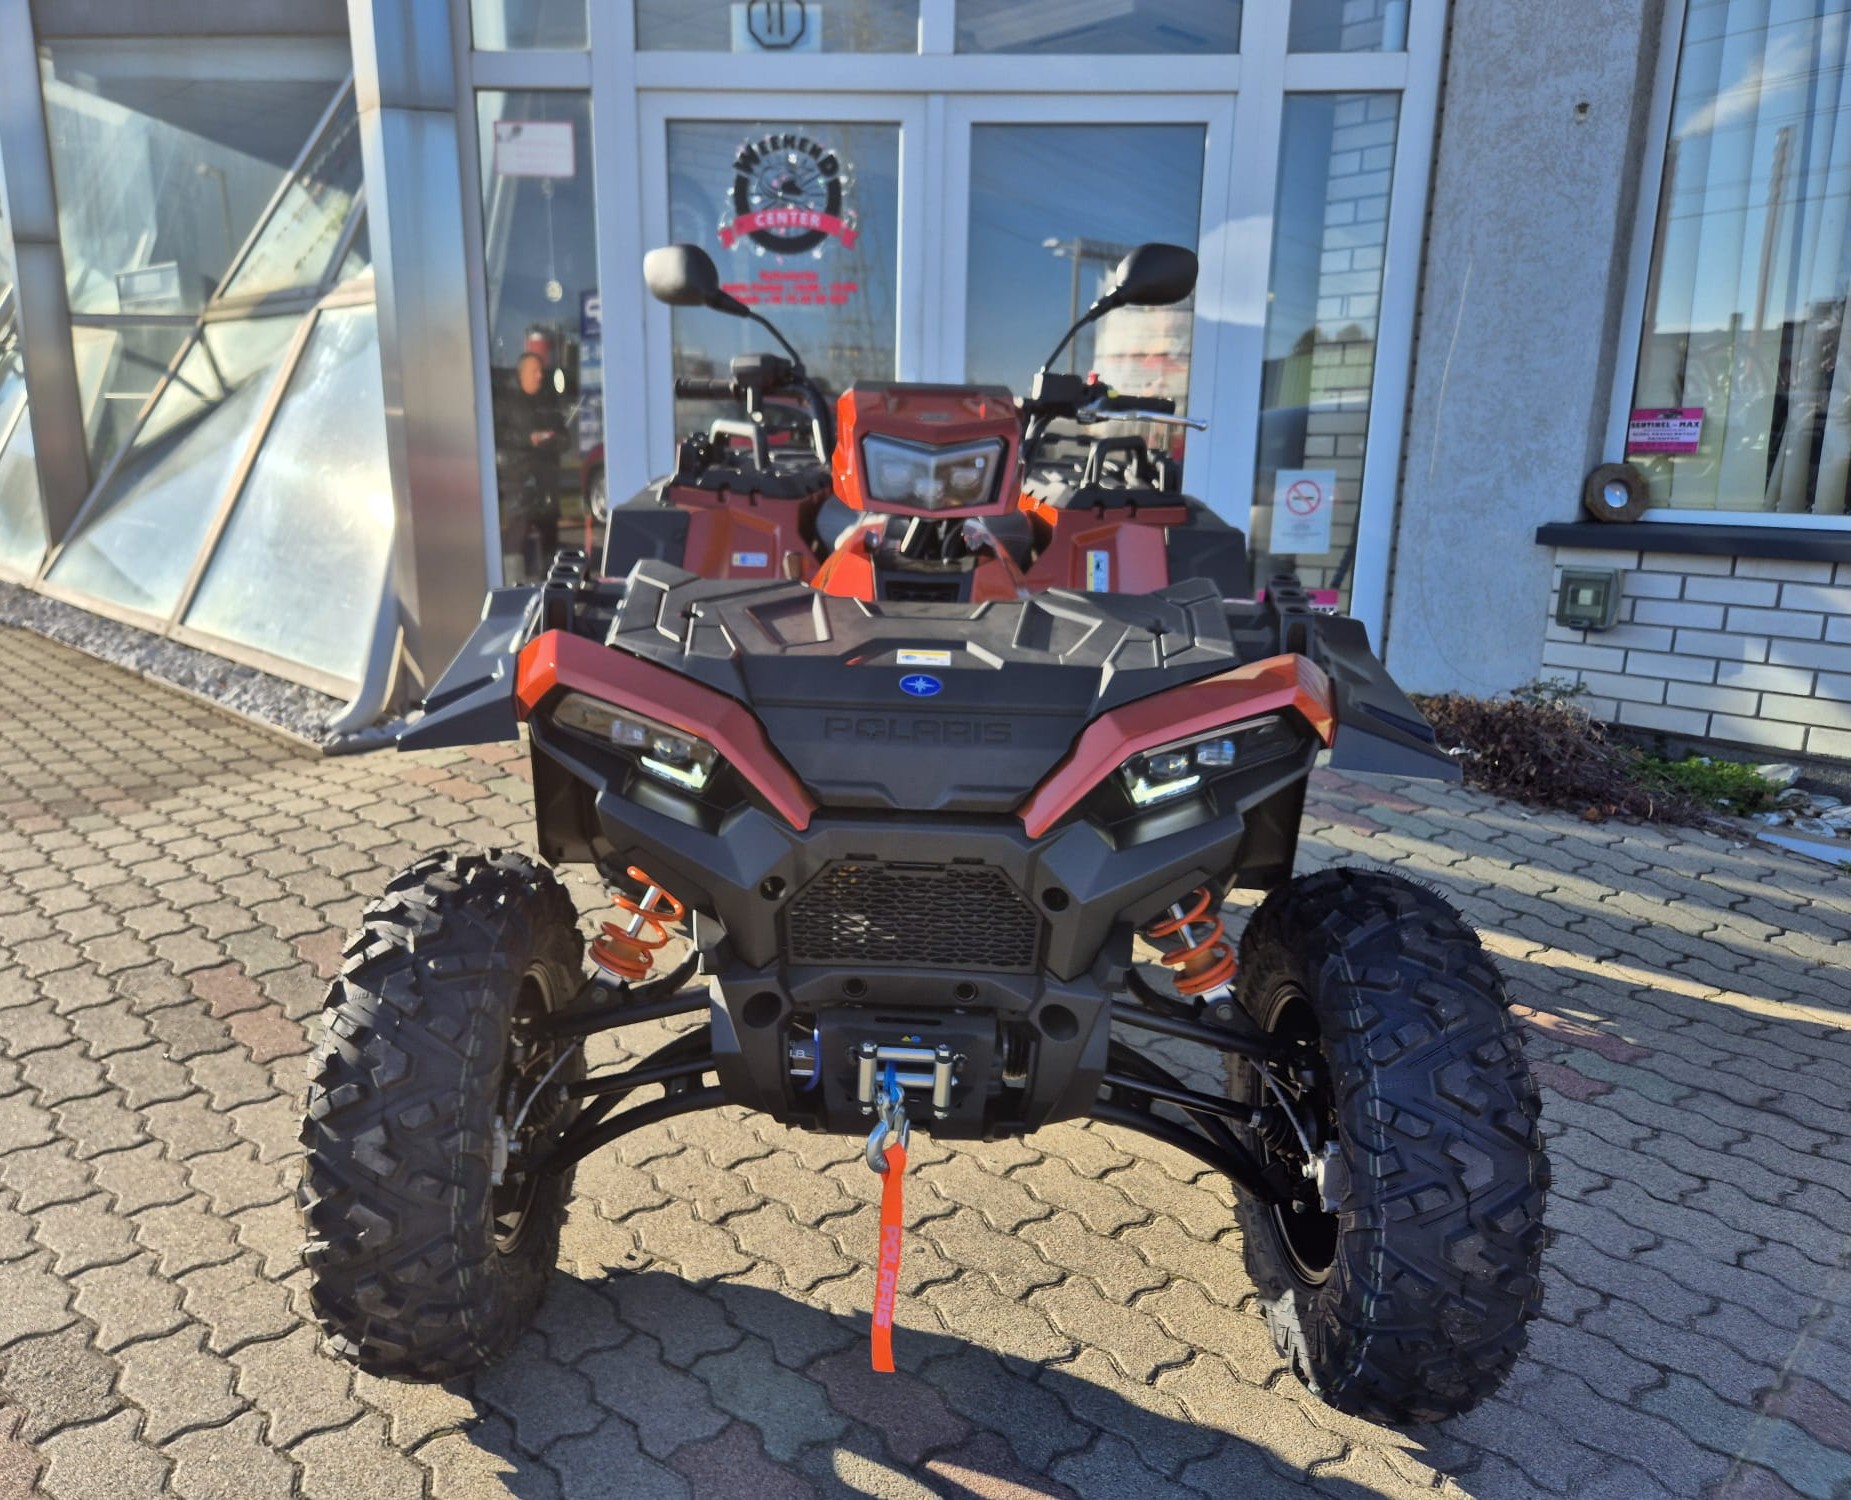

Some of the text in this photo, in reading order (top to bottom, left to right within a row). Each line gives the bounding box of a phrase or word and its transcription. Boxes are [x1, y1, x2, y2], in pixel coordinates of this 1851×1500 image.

[734, 134, 840, 175] WEEKEND
[755, 212, 821, 226] CENTER
[824, 716, 1012, 744] POLARIS
[876, 1225, 900, 1329] POLARIS
